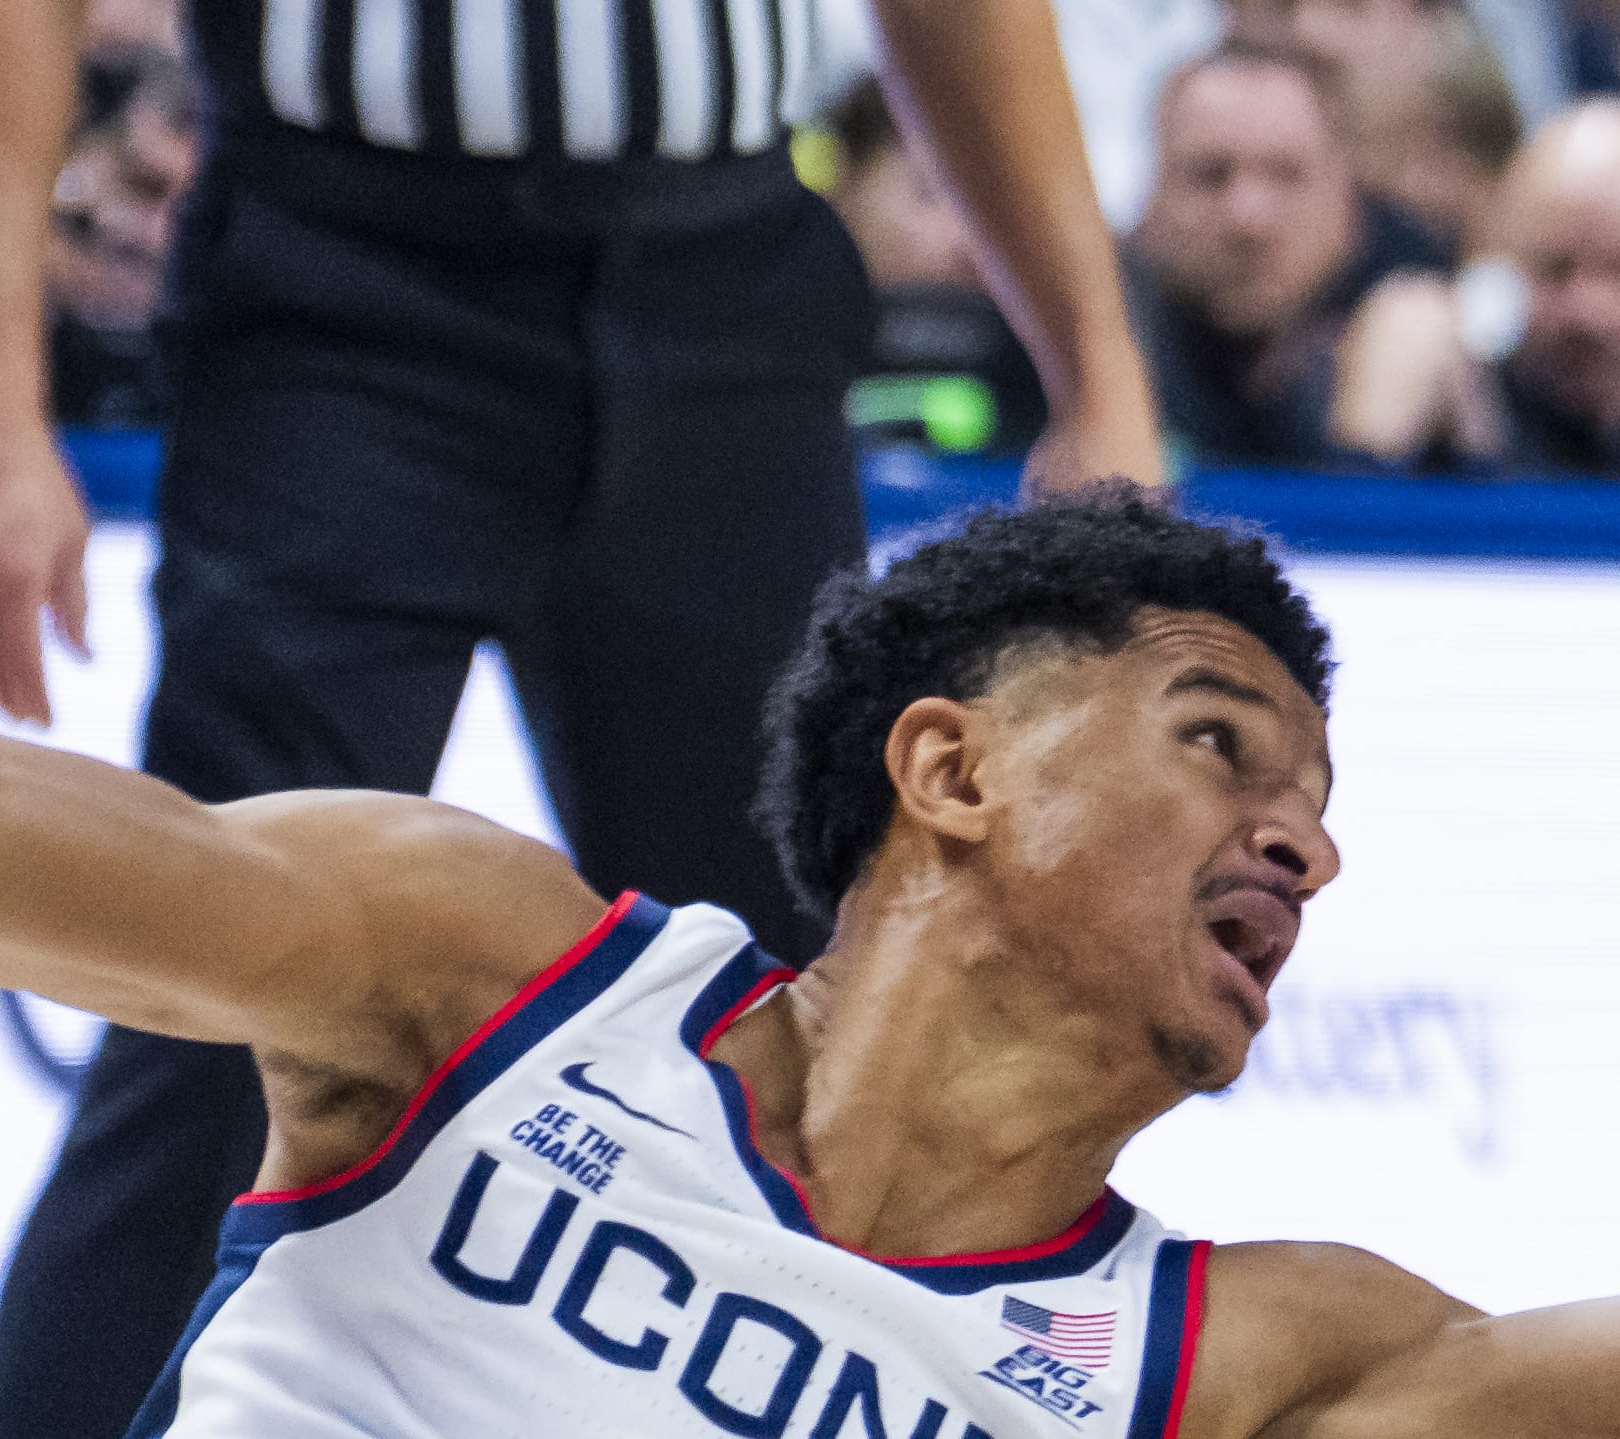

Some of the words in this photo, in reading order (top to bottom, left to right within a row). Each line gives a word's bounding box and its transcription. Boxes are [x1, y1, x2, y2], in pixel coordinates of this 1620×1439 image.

[510, 1119, 614, 1196] CHANGE
[535, 1103, 580, 1136] BE
[576, 1123, 627, 1170] THE
[992, 1355, 1104, 1419] EAST
[1014, 1344, 1095, 1390] BIG
